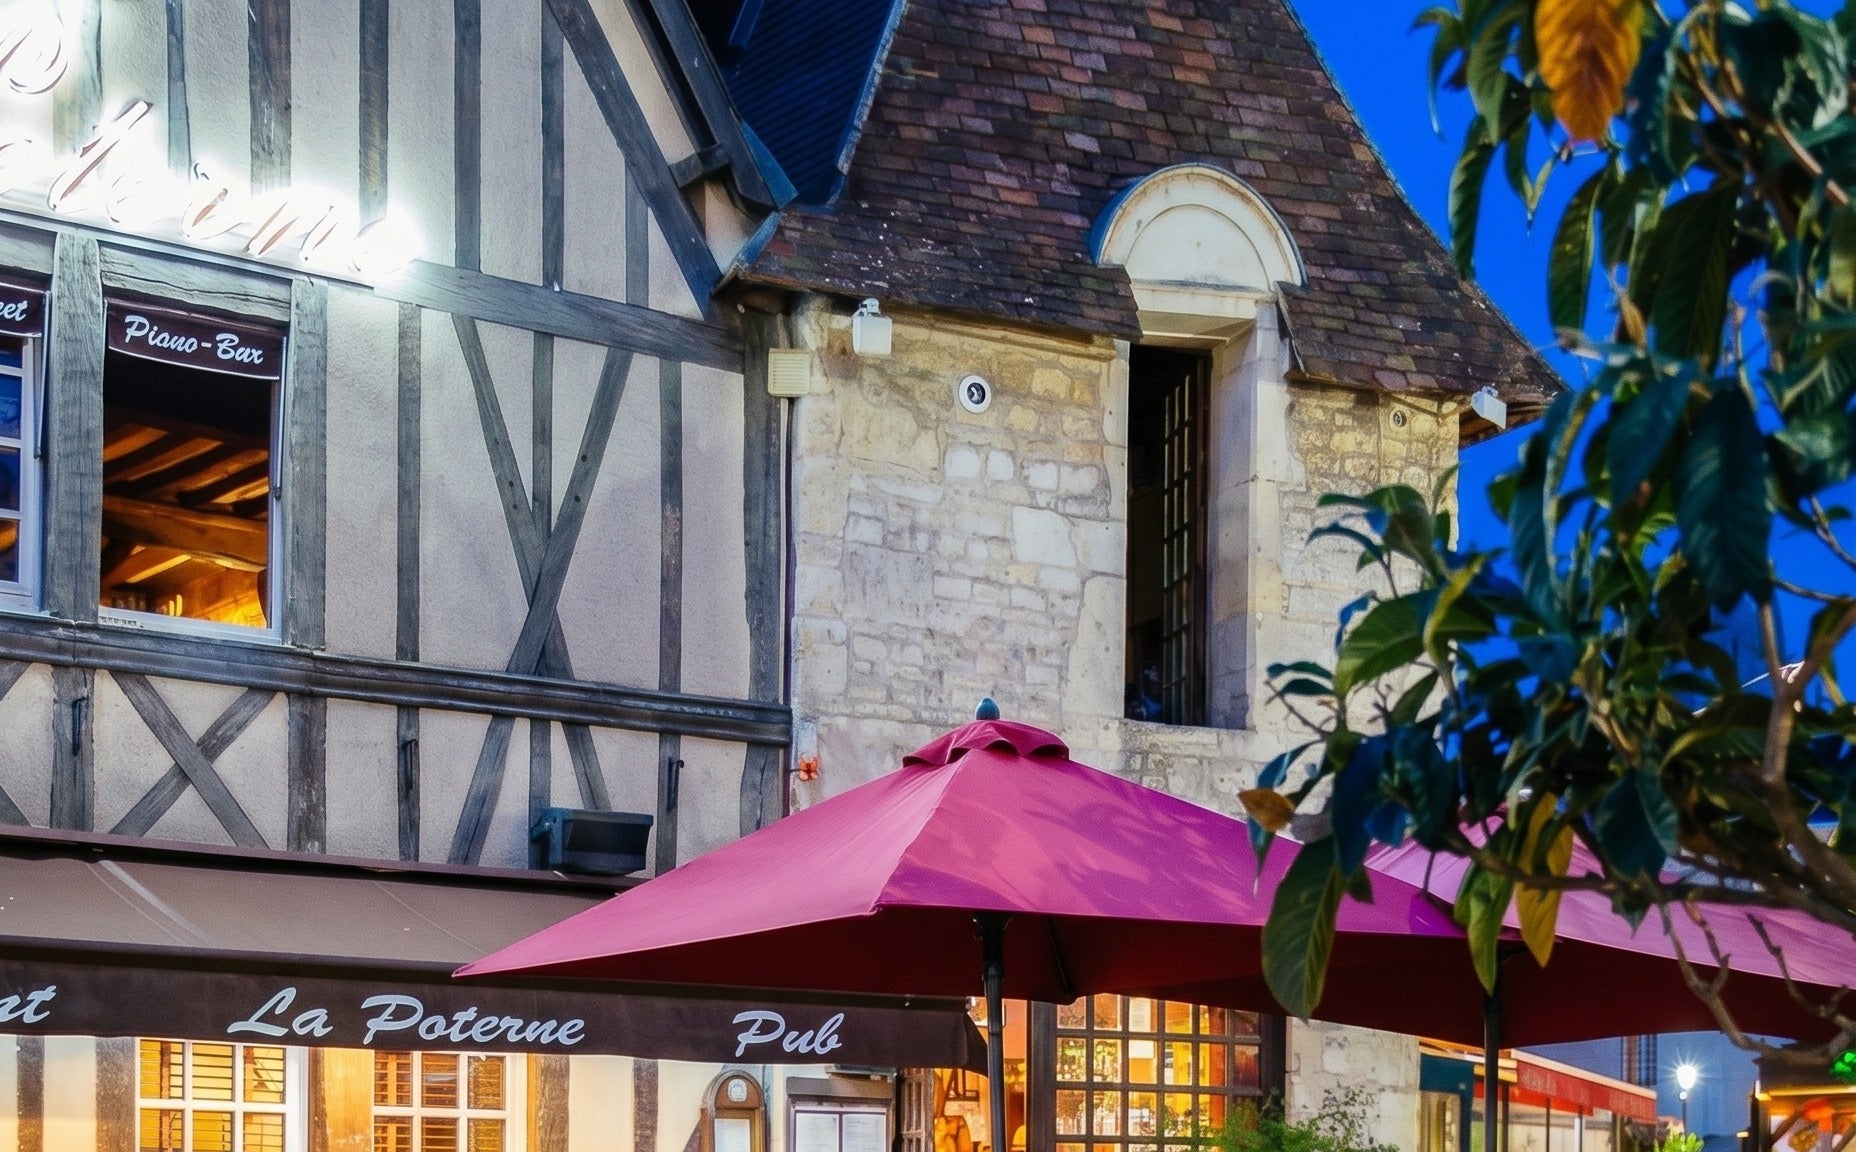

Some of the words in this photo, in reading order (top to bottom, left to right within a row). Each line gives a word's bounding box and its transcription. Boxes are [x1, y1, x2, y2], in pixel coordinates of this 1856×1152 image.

[125, 315, 264, 365] Piano-Bar
[227, 987, 333, 1038] La
[360, 994, 586, 1046] Poterne
[732, 1011, 845, 1058] Pub
